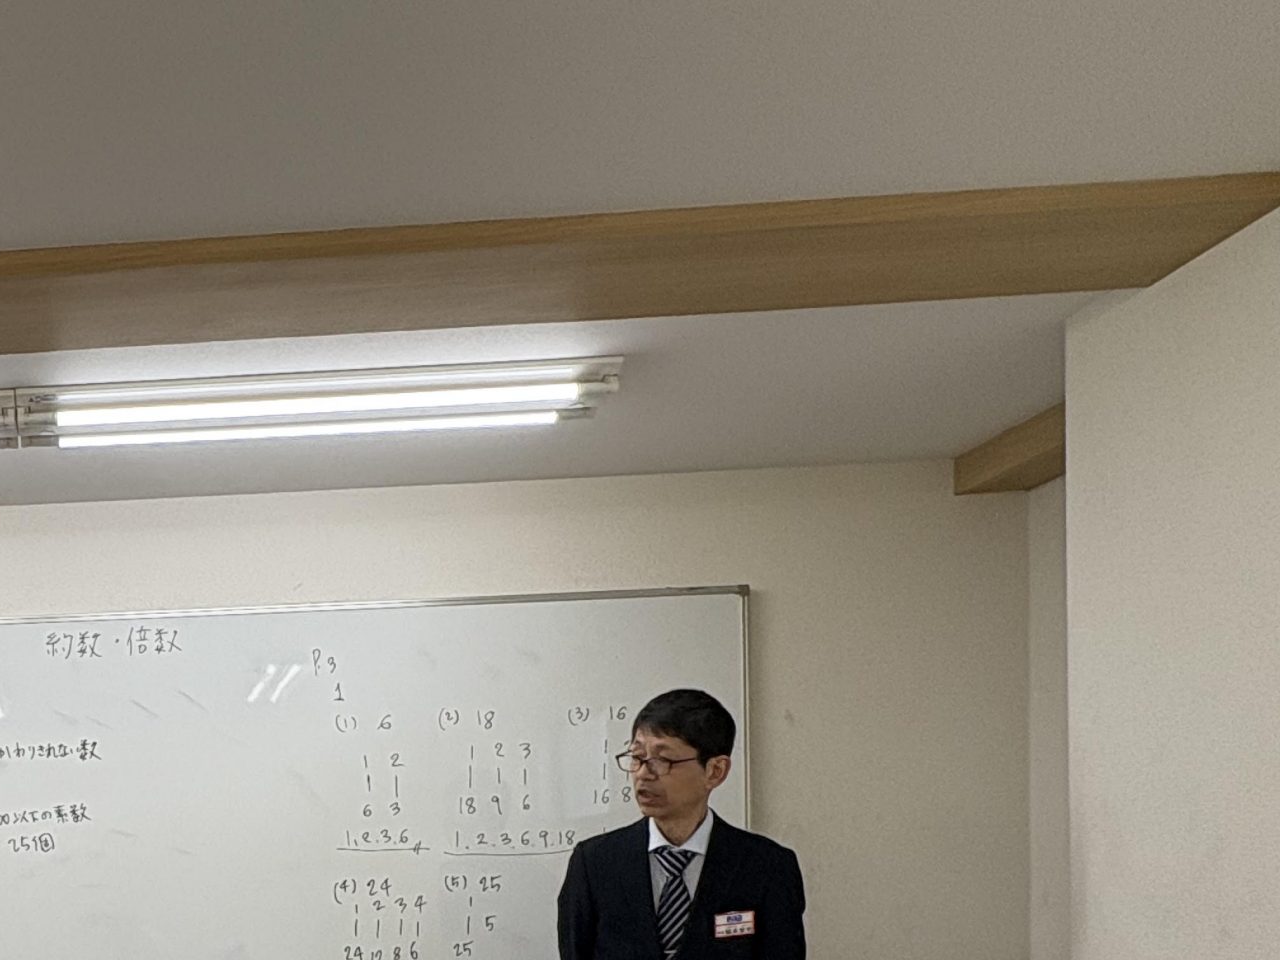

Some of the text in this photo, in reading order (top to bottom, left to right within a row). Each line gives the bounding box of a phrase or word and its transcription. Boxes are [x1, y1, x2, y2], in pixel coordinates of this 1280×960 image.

[45, 626, 182, 659] 約数・倍数
[335, 714, 392, 732] (1) 6
[438, 708, 495, 731] (2) 18
[568, 705, 627, 726] (3) 16
[390, 753, 405, 767] 2
[494, 743, 505, 757] 2
[519, 743, 531, 759] 3
[593, 786, 632, 804] 16 8
[363, 802, 401, 817] 6 3
[459, 794, 531, 815] 18 9 6
[334, 878, 392, 904] (4) 24
[444, 875, 502, 892] (5) 25
[372, 900, 386, 911] 2
[414, 895, 427, 913] 4
[485, 915, 497, 932] 5
[393, 946, 402, 960] 8
[409, 941, 419, 960] 6
[453, 940, 474, 957] 25
